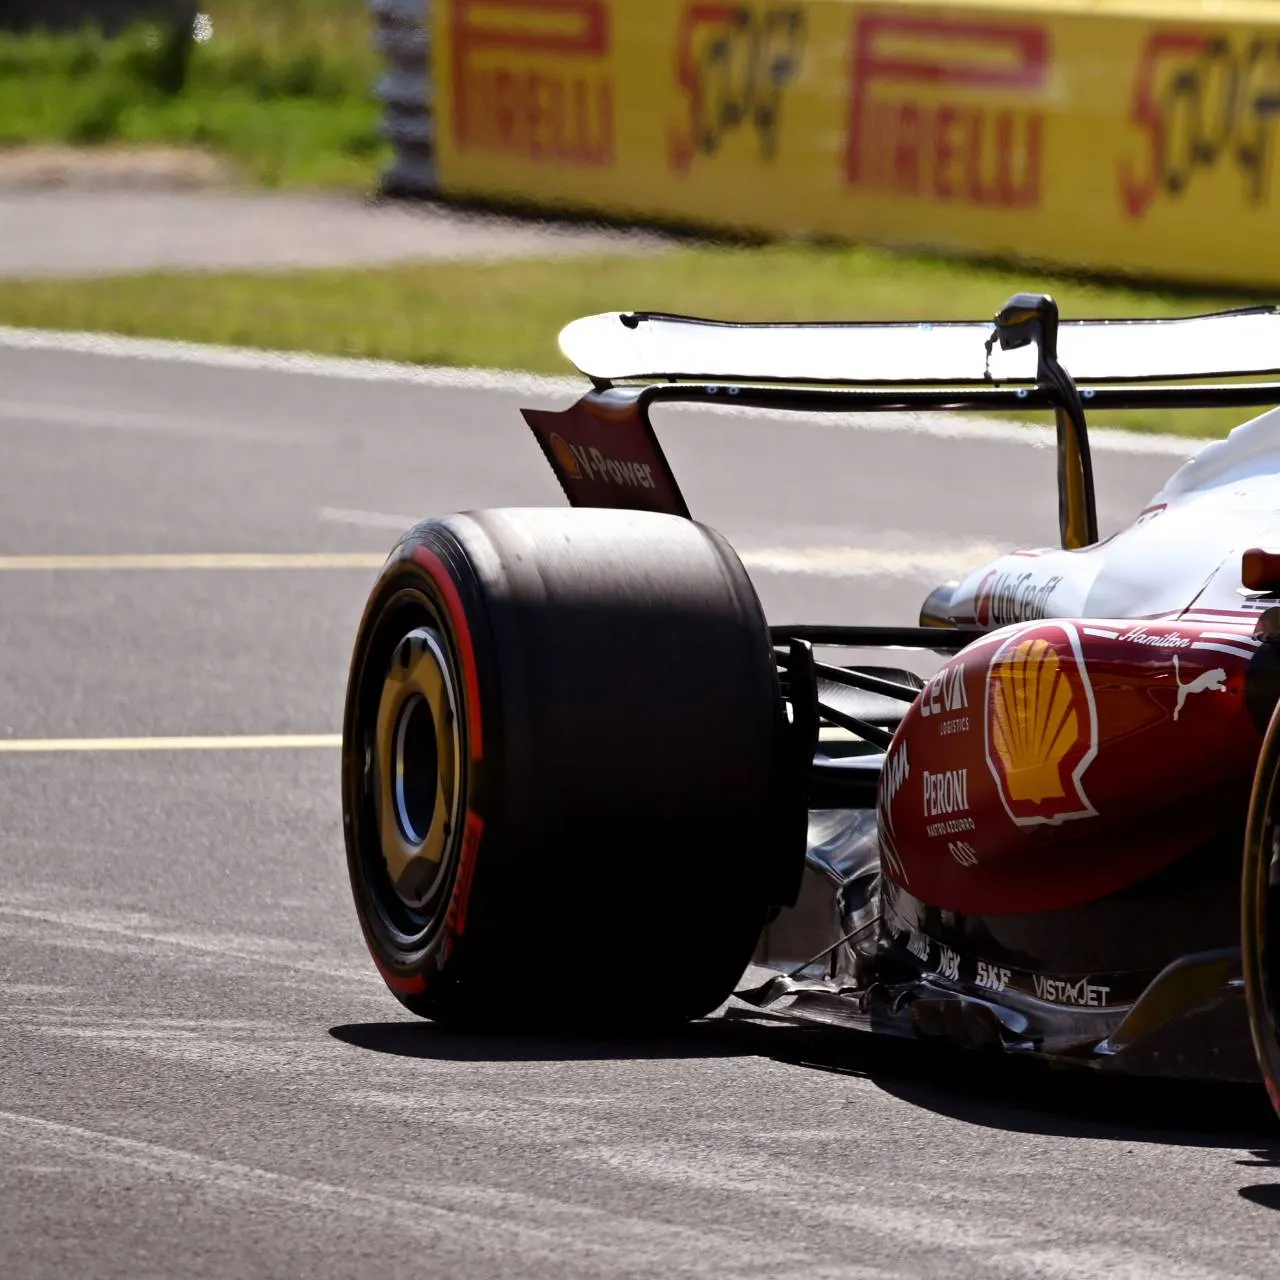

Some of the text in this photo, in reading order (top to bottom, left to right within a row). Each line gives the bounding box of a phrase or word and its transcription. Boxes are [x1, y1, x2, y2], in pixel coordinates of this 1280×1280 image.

[847, 11, 1051, 210] PIRELLI
[1119, 627, 1191, 648] Hamilton
[940, 717, 969, 736] LOGISTICS
[923, 768, 969, 817] PERONI
[974, 961, 1011, 992] SKF
